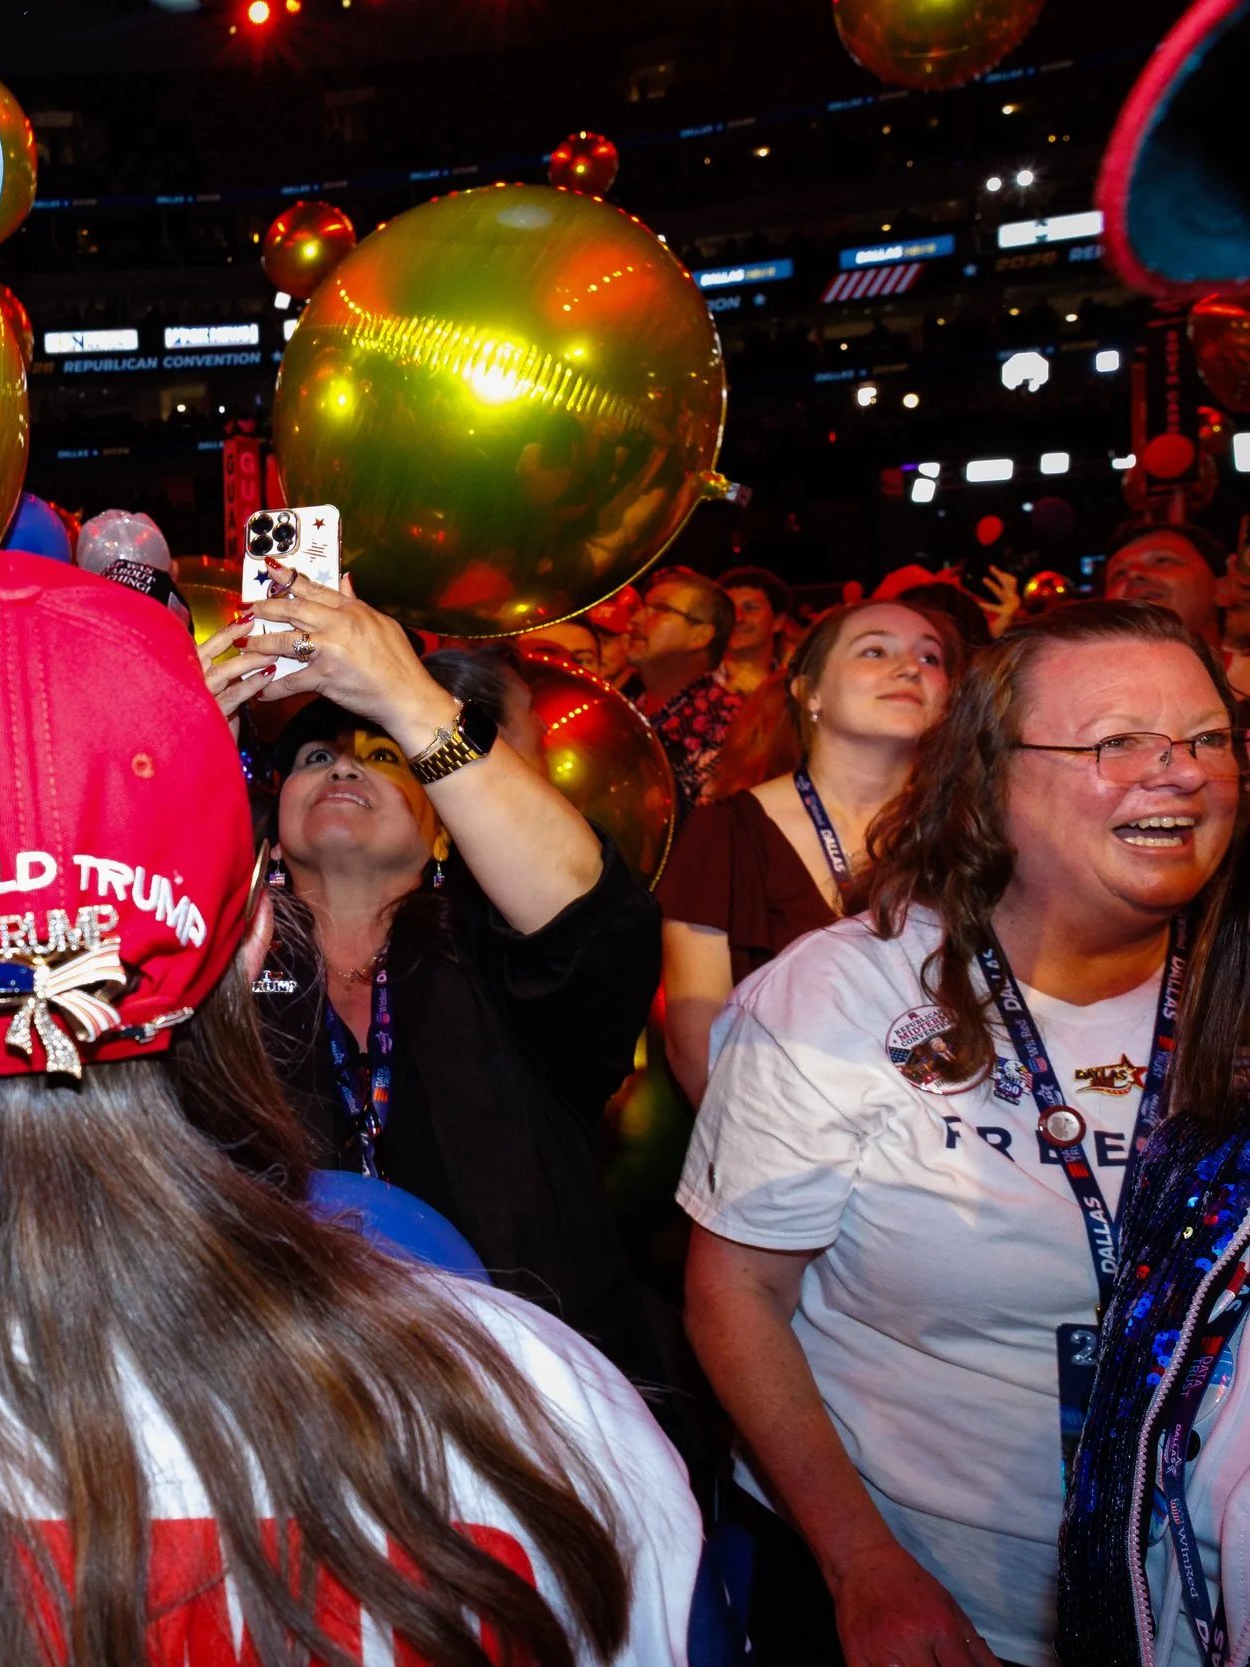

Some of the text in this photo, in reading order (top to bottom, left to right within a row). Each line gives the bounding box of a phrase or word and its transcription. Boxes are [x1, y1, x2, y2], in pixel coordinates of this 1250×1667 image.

[63, 356, 159, 374] REPUBLICAN
[162, 350, 262, 369] CONVENTION
[73, 854, 207, 948] TRUMP
[901, 1019, 951, 1048] CONVENTIO
[999, 1079, 1020, 1095] 250
[1084, 1197, 1119, 1275] DALLAS
[1181, 1355, 1214, 1398] DATA TRUST
[1178, 1528, 1199, 1599] WinRed
